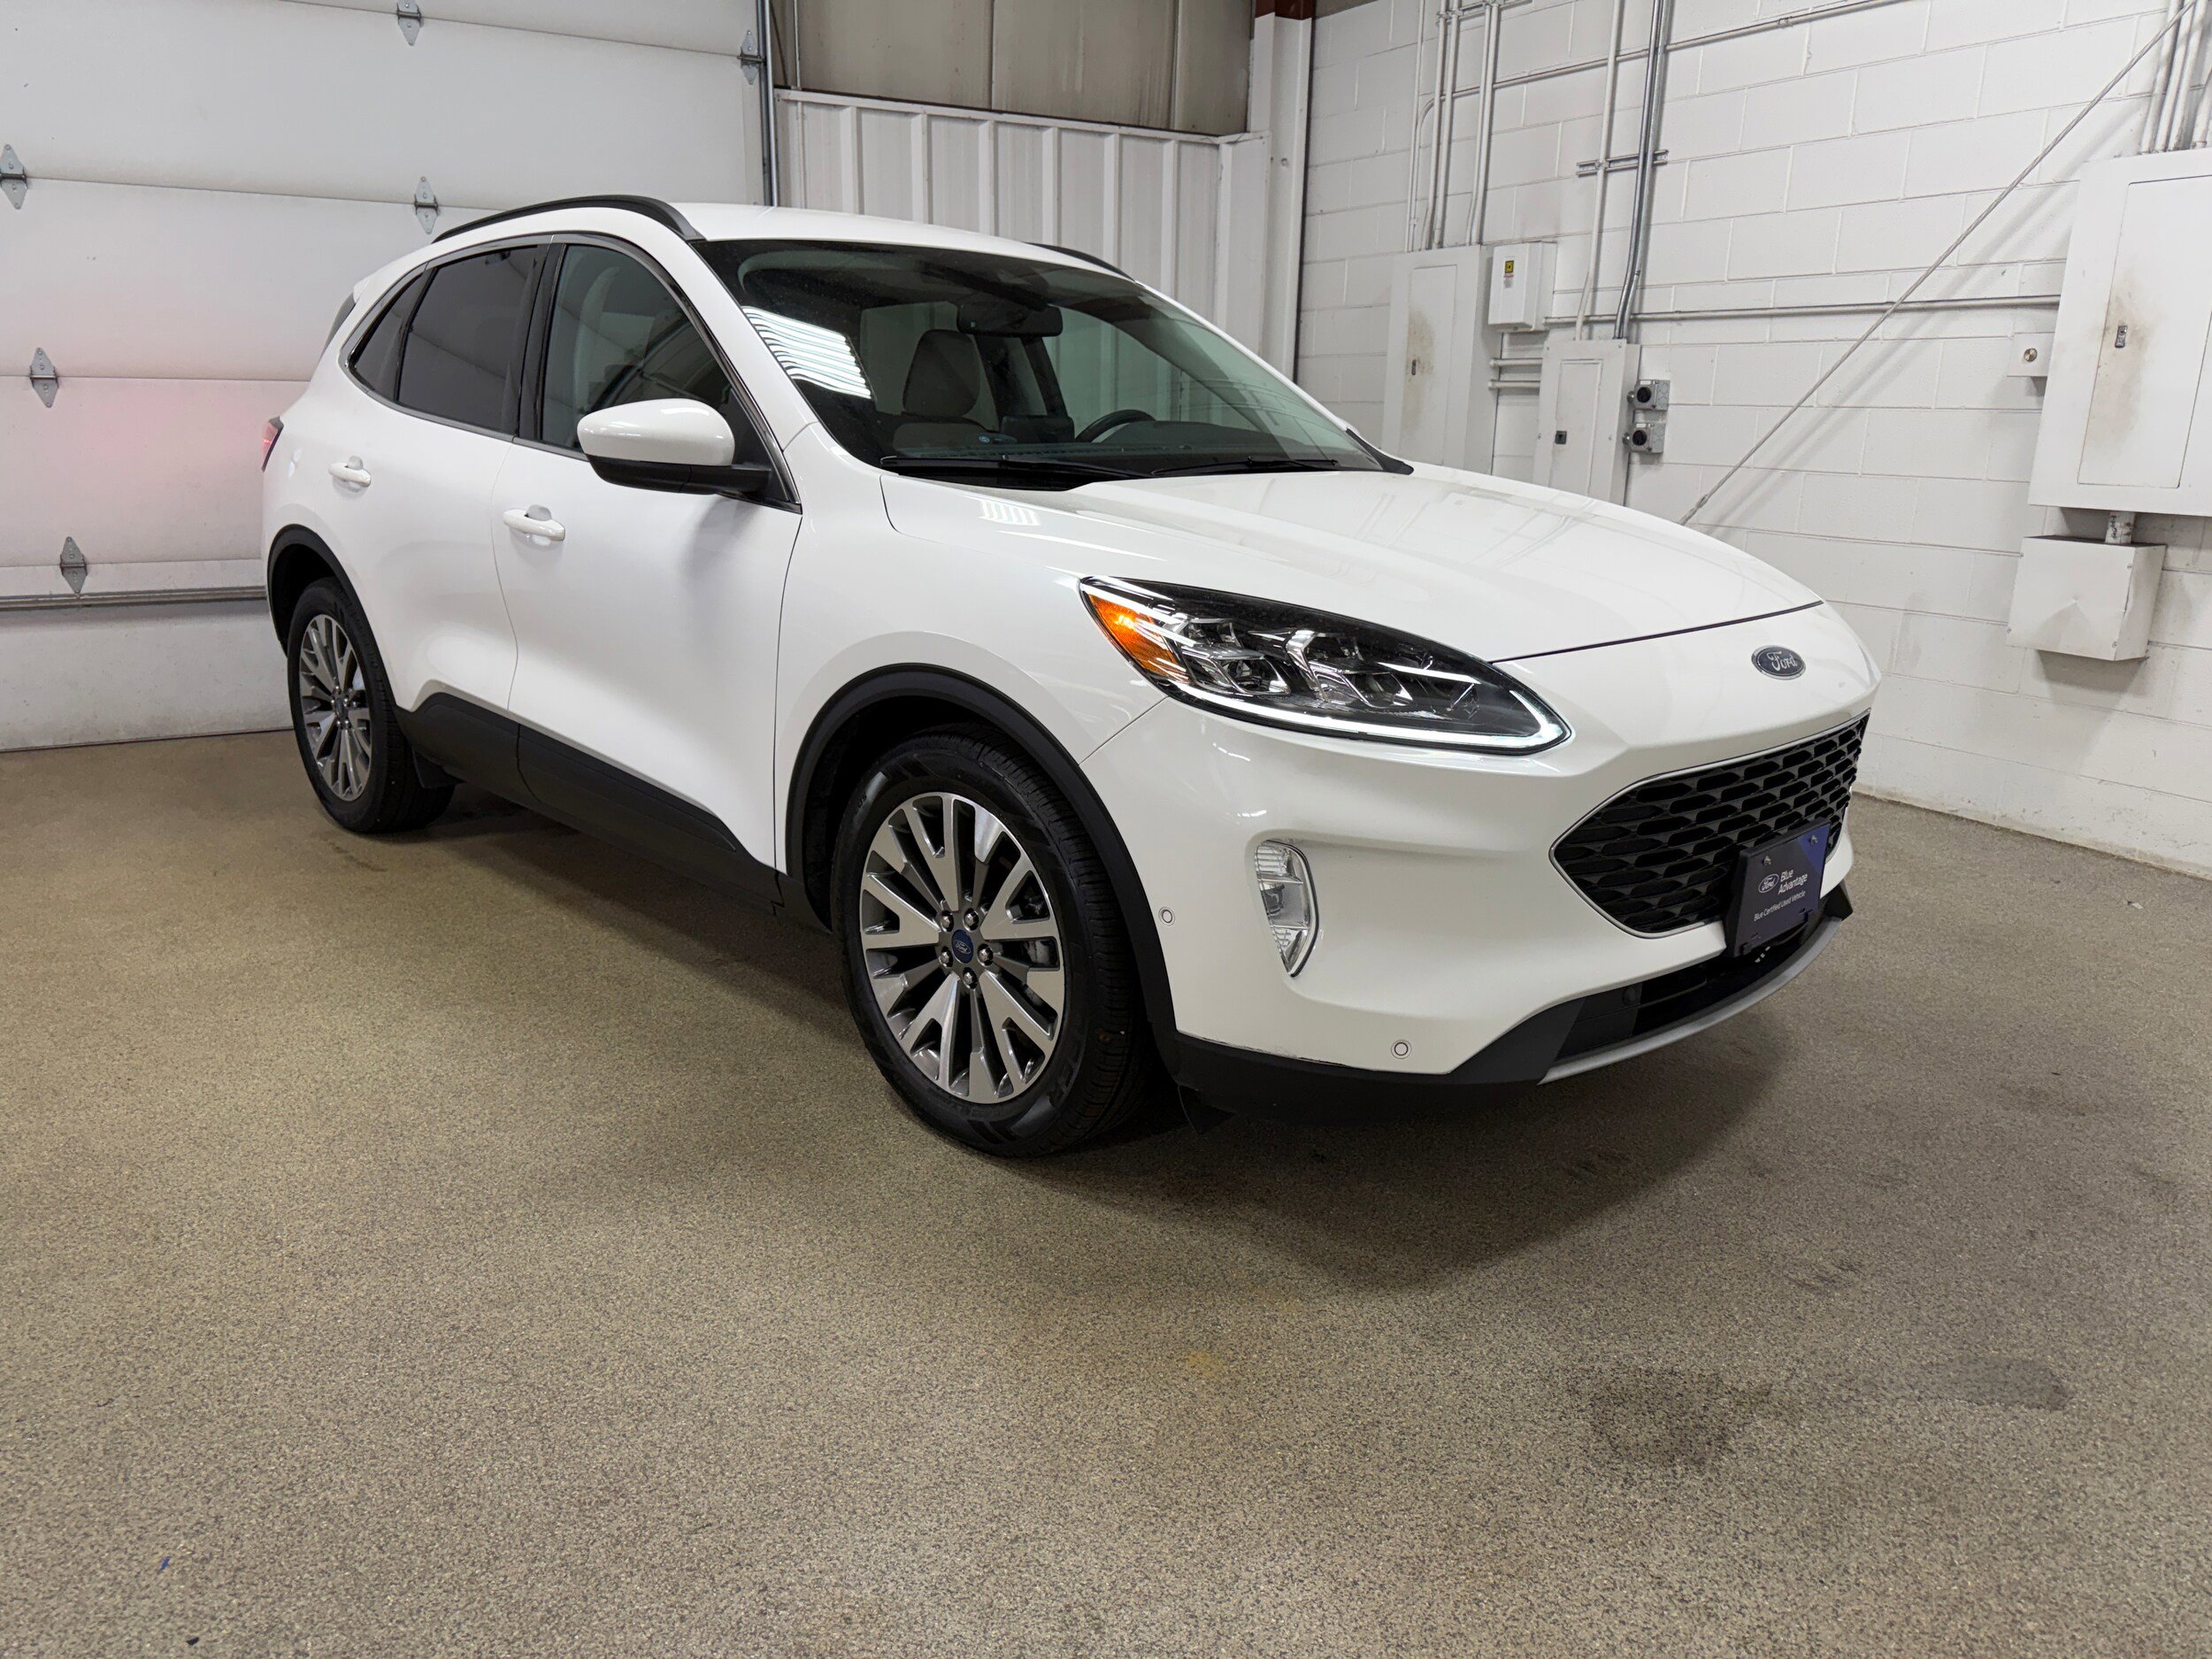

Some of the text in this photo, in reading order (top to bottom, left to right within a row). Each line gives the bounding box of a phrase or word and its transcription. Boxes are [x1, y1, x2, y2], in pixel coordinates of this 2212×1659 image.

[1766, 651, 1798, 671] Ford
[1778, 873, 1808, 895] Advantage
[1780, 870, 1793, 882] Blue
[1754, 912, 1763, 922] Blue
